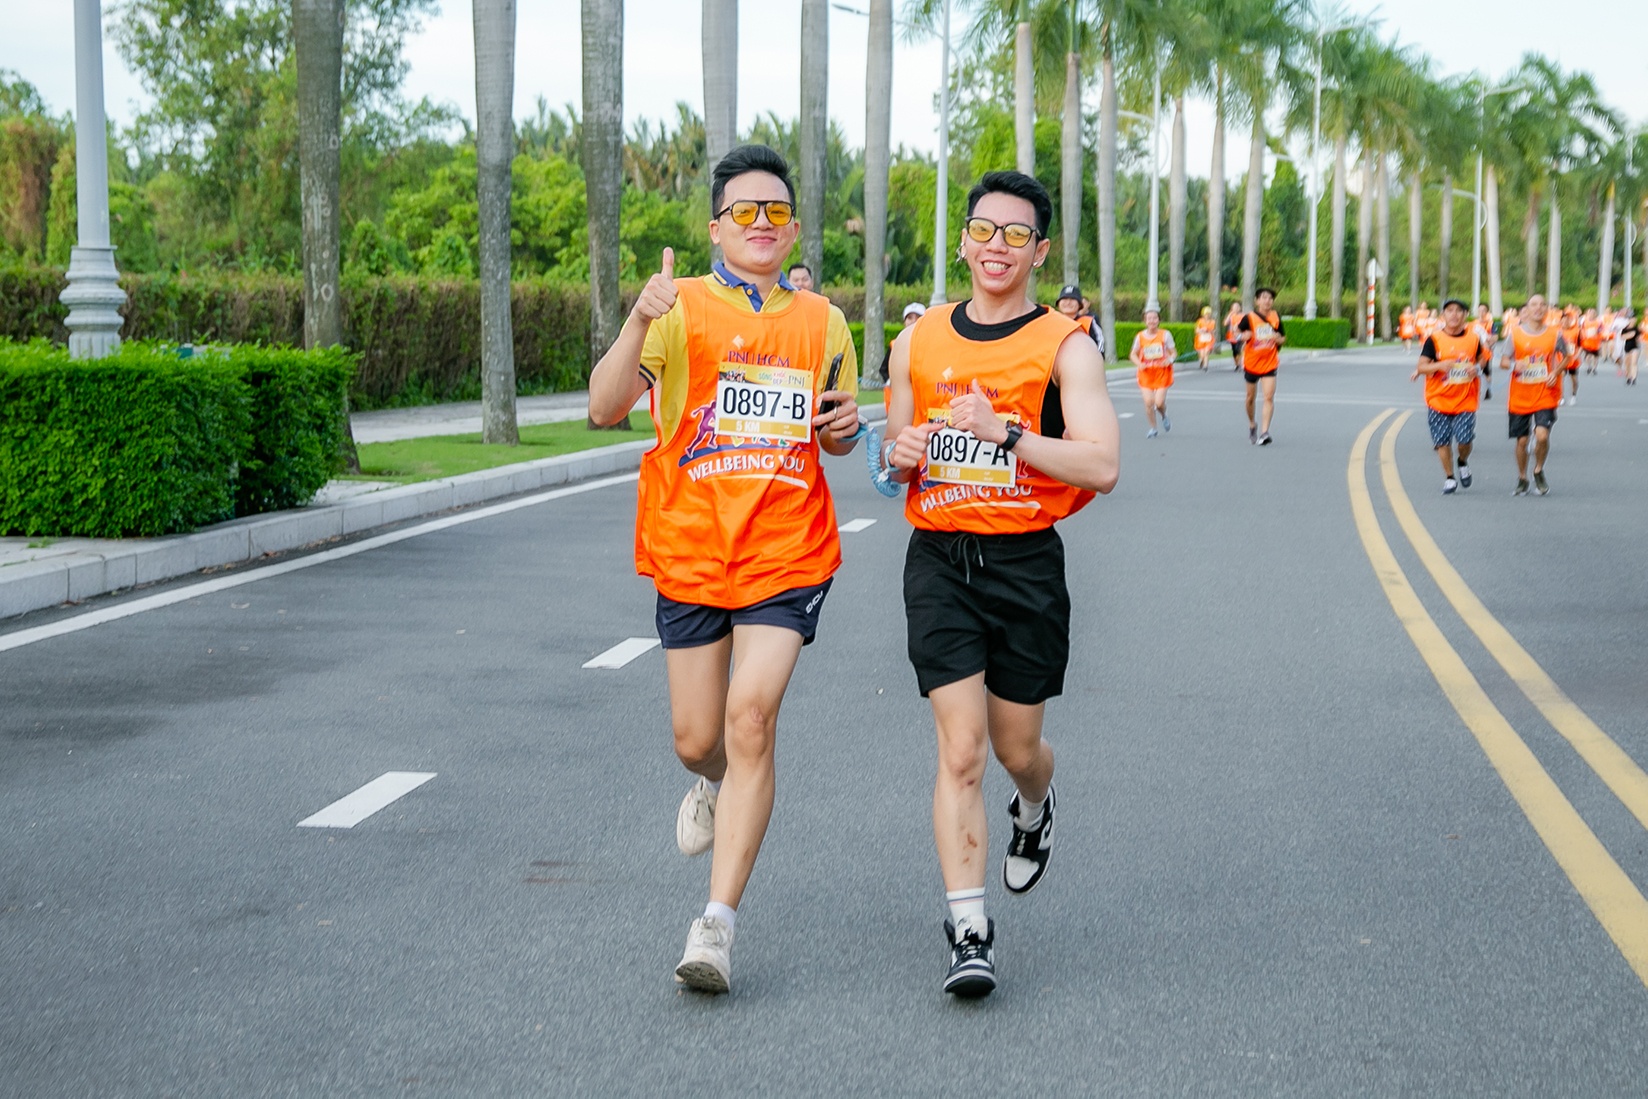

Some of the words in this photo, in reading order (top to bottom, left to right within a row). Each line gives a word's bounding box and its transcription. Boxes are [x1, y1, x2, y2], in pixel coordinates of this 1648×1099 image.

[757, 354, 790, 367] HCM
[788, 374, 805, 387] PNJ
[936, 382, 957, 397] PNJ
[723, 386, 806, 421] 0897-B
[736, 421, 742, 431] 5
[744, 421, 760, 433] KM
[930, 431, 1009, 467] 0897-A
[687, 454, 774, 482] WELLBEING
[940, 467, 945, 477] 5
[946, 467, 961, 479] KM
